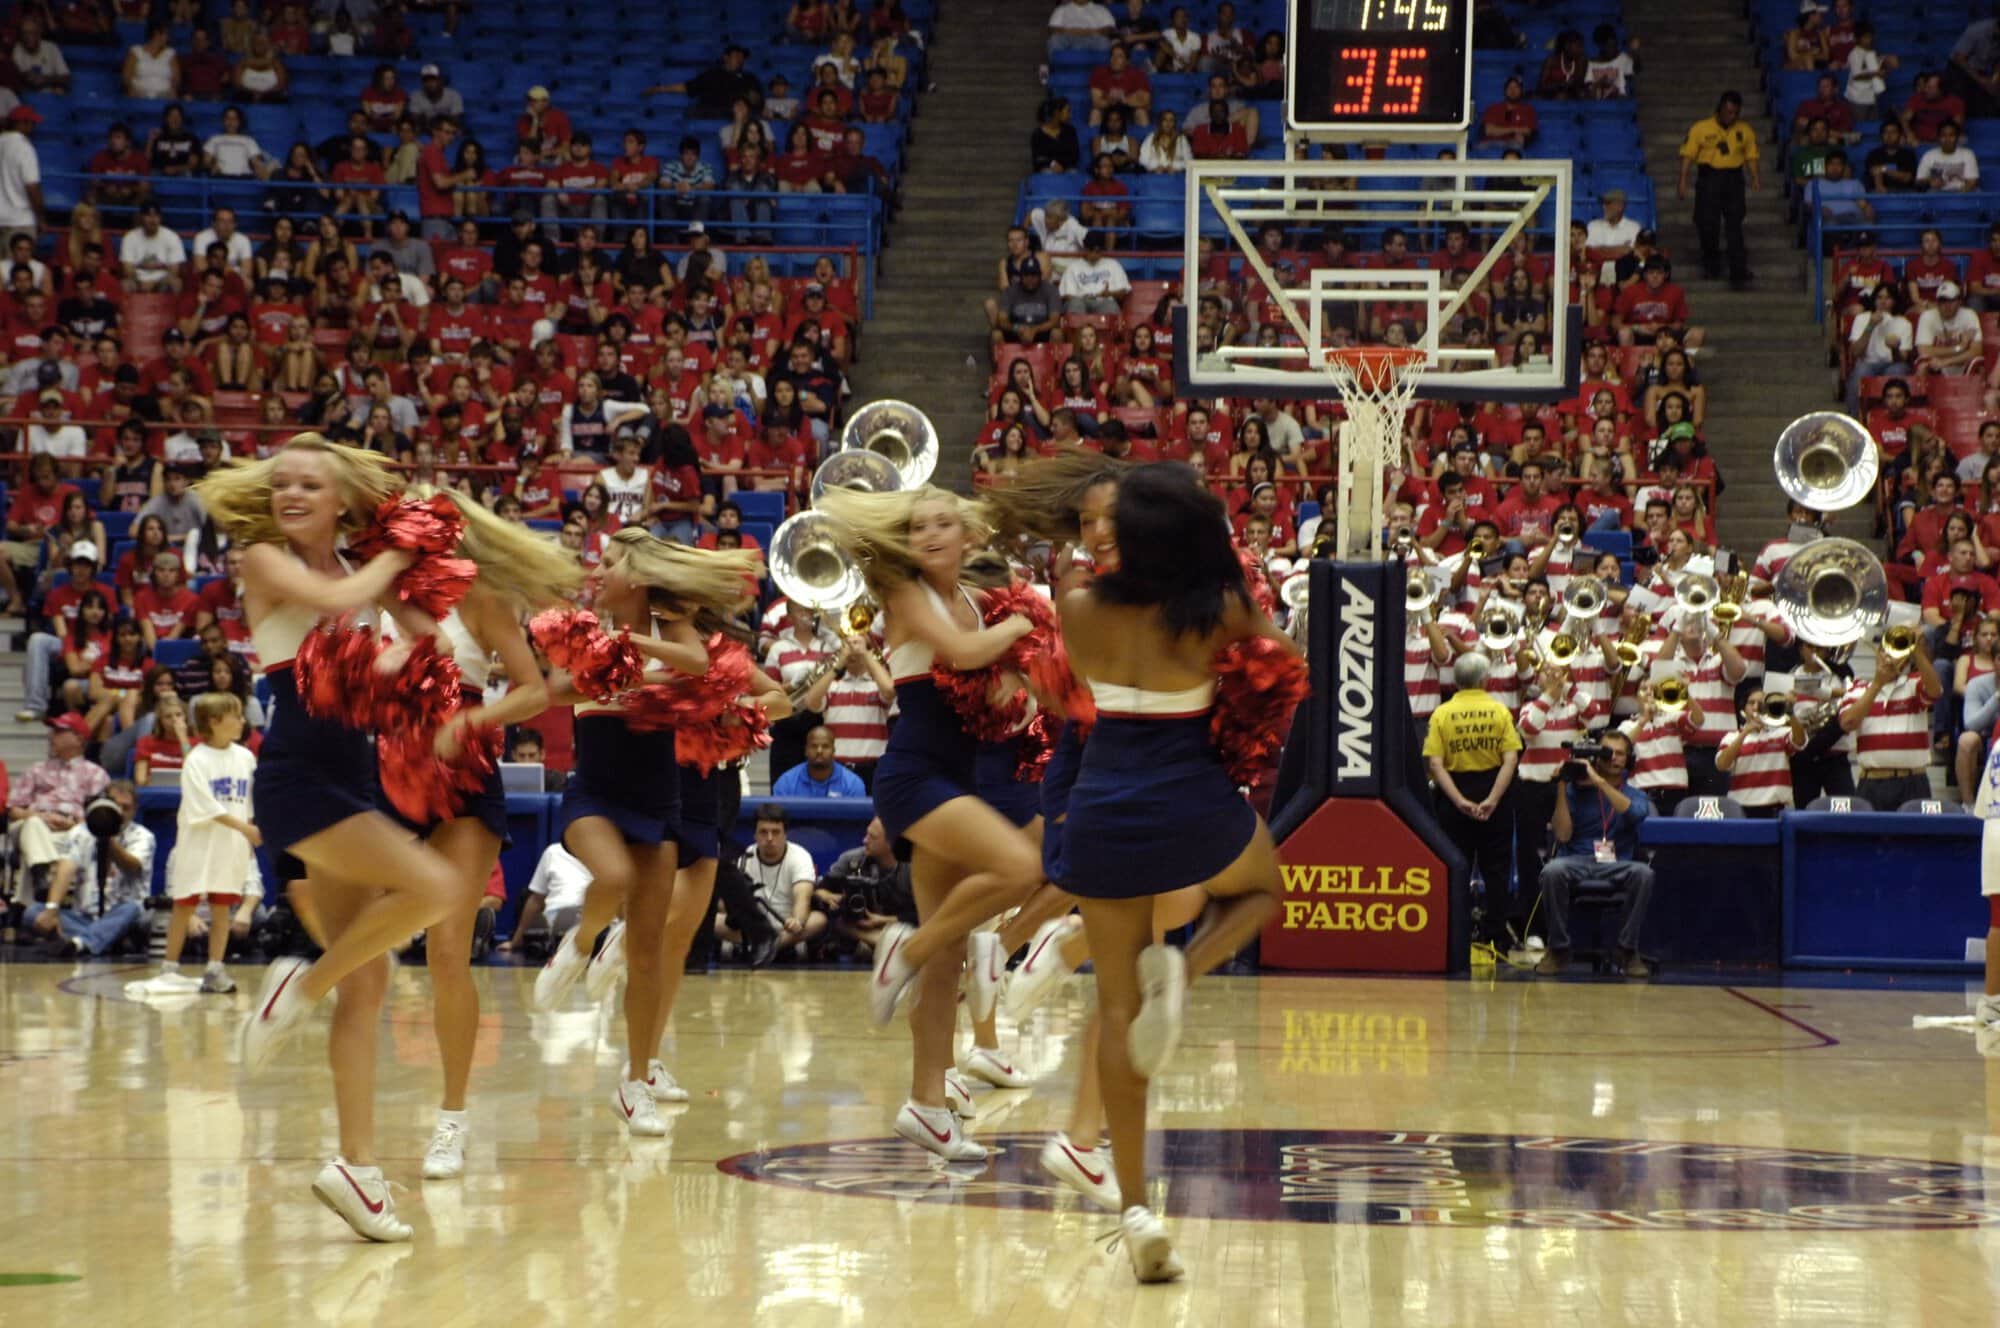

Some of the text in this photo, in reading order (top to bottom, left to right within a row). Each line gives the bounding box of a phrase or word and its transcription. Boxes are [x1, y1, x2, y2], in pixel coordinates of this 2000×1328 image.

[1361, 0, 1447, 30] 1:45
[1333, 48, 1427, 114] 35
[1338, 577, 1374, 777] ARIZONA
[1451, 710, 1495, 721] EVENT
[1455, 724, 1495, 734] STAFF
[1449, 737, 1502, 753] SECURITY
[1278, 864, 1431, 895] WELLS
[1282, 901, 1428, 932] FARGO
